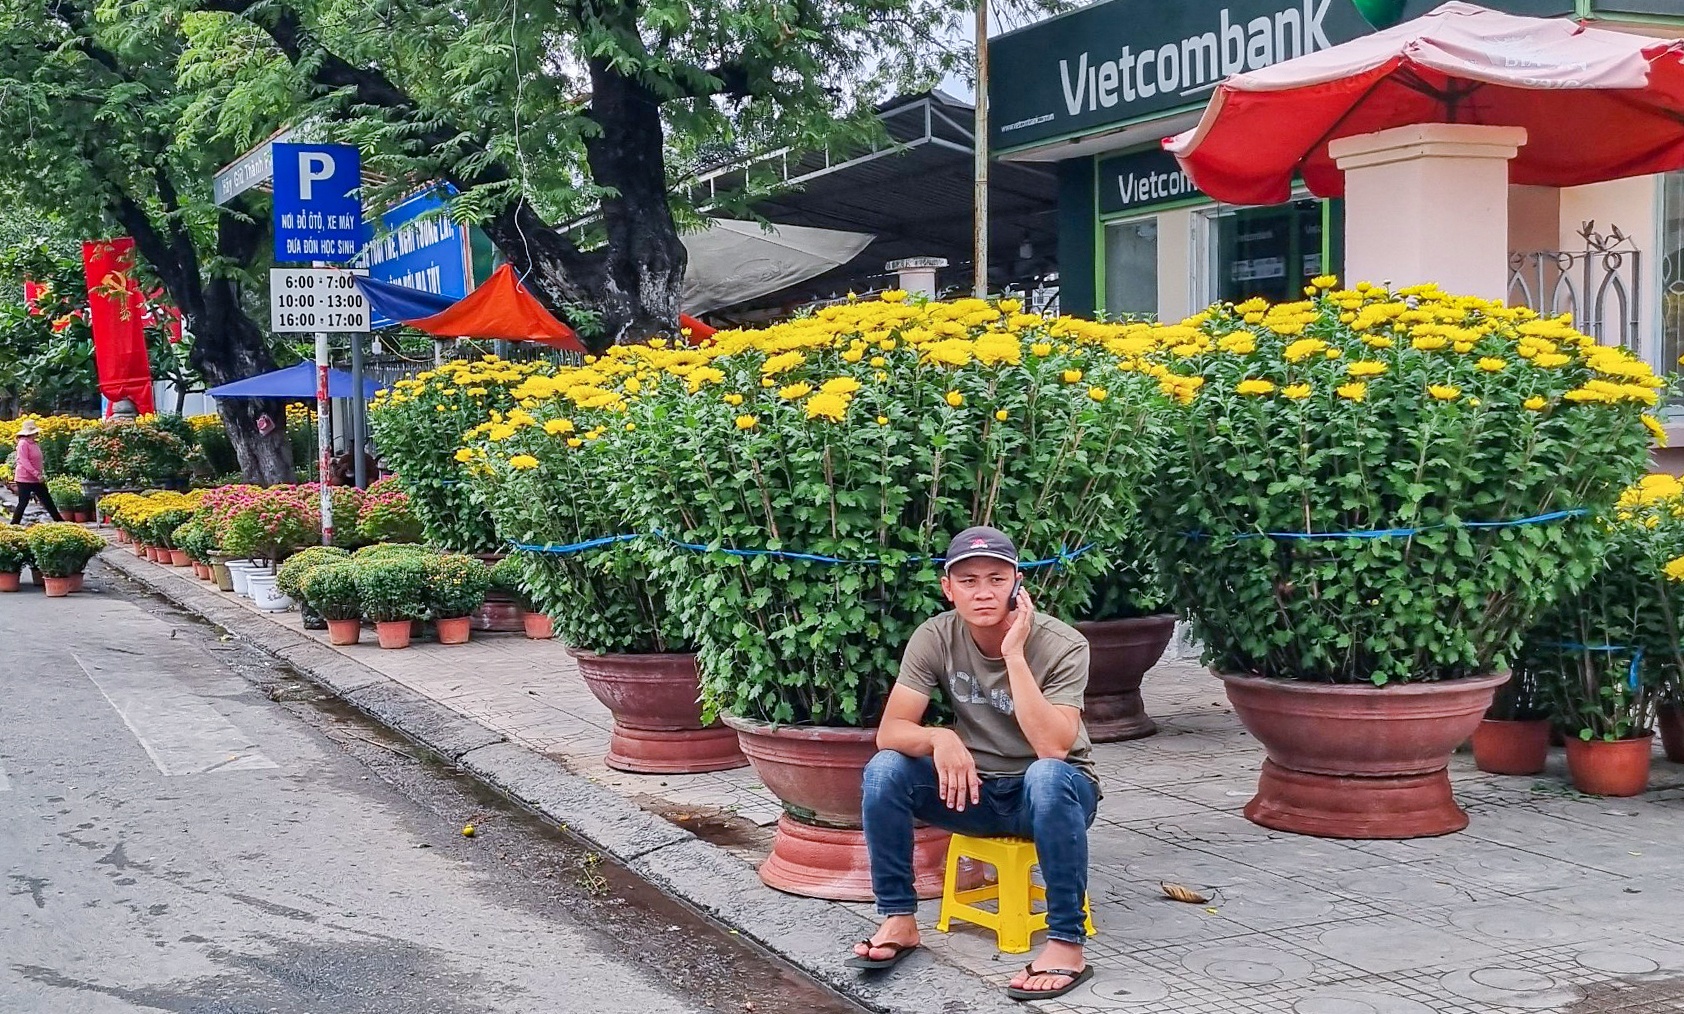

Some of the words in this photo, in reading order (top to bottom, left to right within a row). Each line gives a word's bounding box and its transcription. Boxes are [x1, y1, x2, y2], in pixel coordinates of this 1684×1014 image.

[1059, 0, 1333, 116] Vietcombank
[298, 151, 336, 200] P
[327, 215, 337, 230] XE
[339, 212, 354, 230] MÁY
[287, 237, 301, 254] ĐƯA
[303, 236, 318, 254] ĐÓN
[321, 239, 335, 257] HỌC
[286, 275, 314, 288] 6:00
[327, 276, 354, 289] 7:00
[279, 295, 315, 307] 10:00
[328, 295, 363, 307] 13:00
[280, 313, 315, 326] 16:00
[328, 314, 363, 326] 17:00
